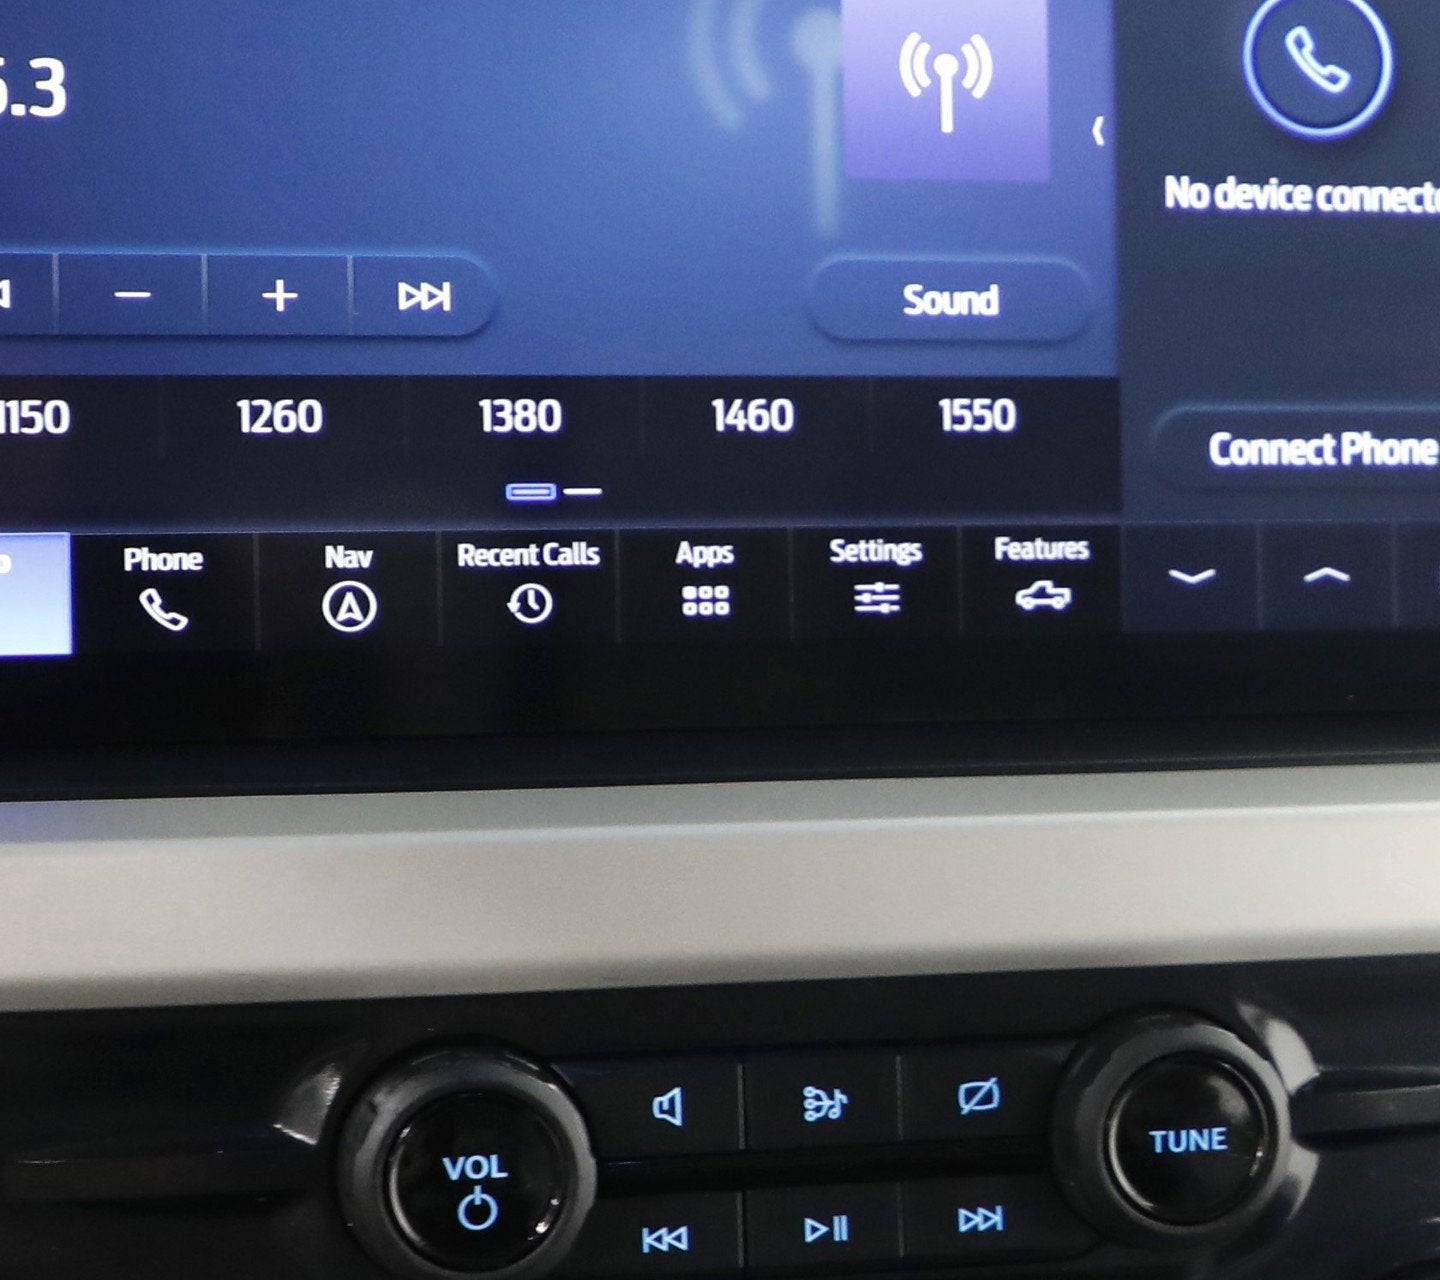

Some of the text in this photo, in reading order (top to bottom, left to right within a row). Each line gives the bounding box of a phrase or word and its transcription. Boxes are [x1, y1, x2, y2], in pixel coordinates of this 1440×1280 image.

[1163, 173, 1211, 210] No
[1212, 174, 1314, 212] device
[902, 282, 1000, 317] Sound
[235, 397, 323, 434] 1260
[477, 397, 562, 433] 1380
[710, 397, 794, 433] 1460
[937, 396, 1017, 432] 1550
[1207, 429, 1440, 469] Connect Phone
[122, 545, 204, 572] Phone
[323, 544, 374, 570] Nav
[456, 540, 601, 568] Recent Calls
[674, 539, 735, 569] Apps
[828, 537, 924, 568] Settings
[993, 535, 1091, 562] Features
[1148, 1125, 1228, 1153] TUNE
[441, 1153, 509, 1181] VOL
